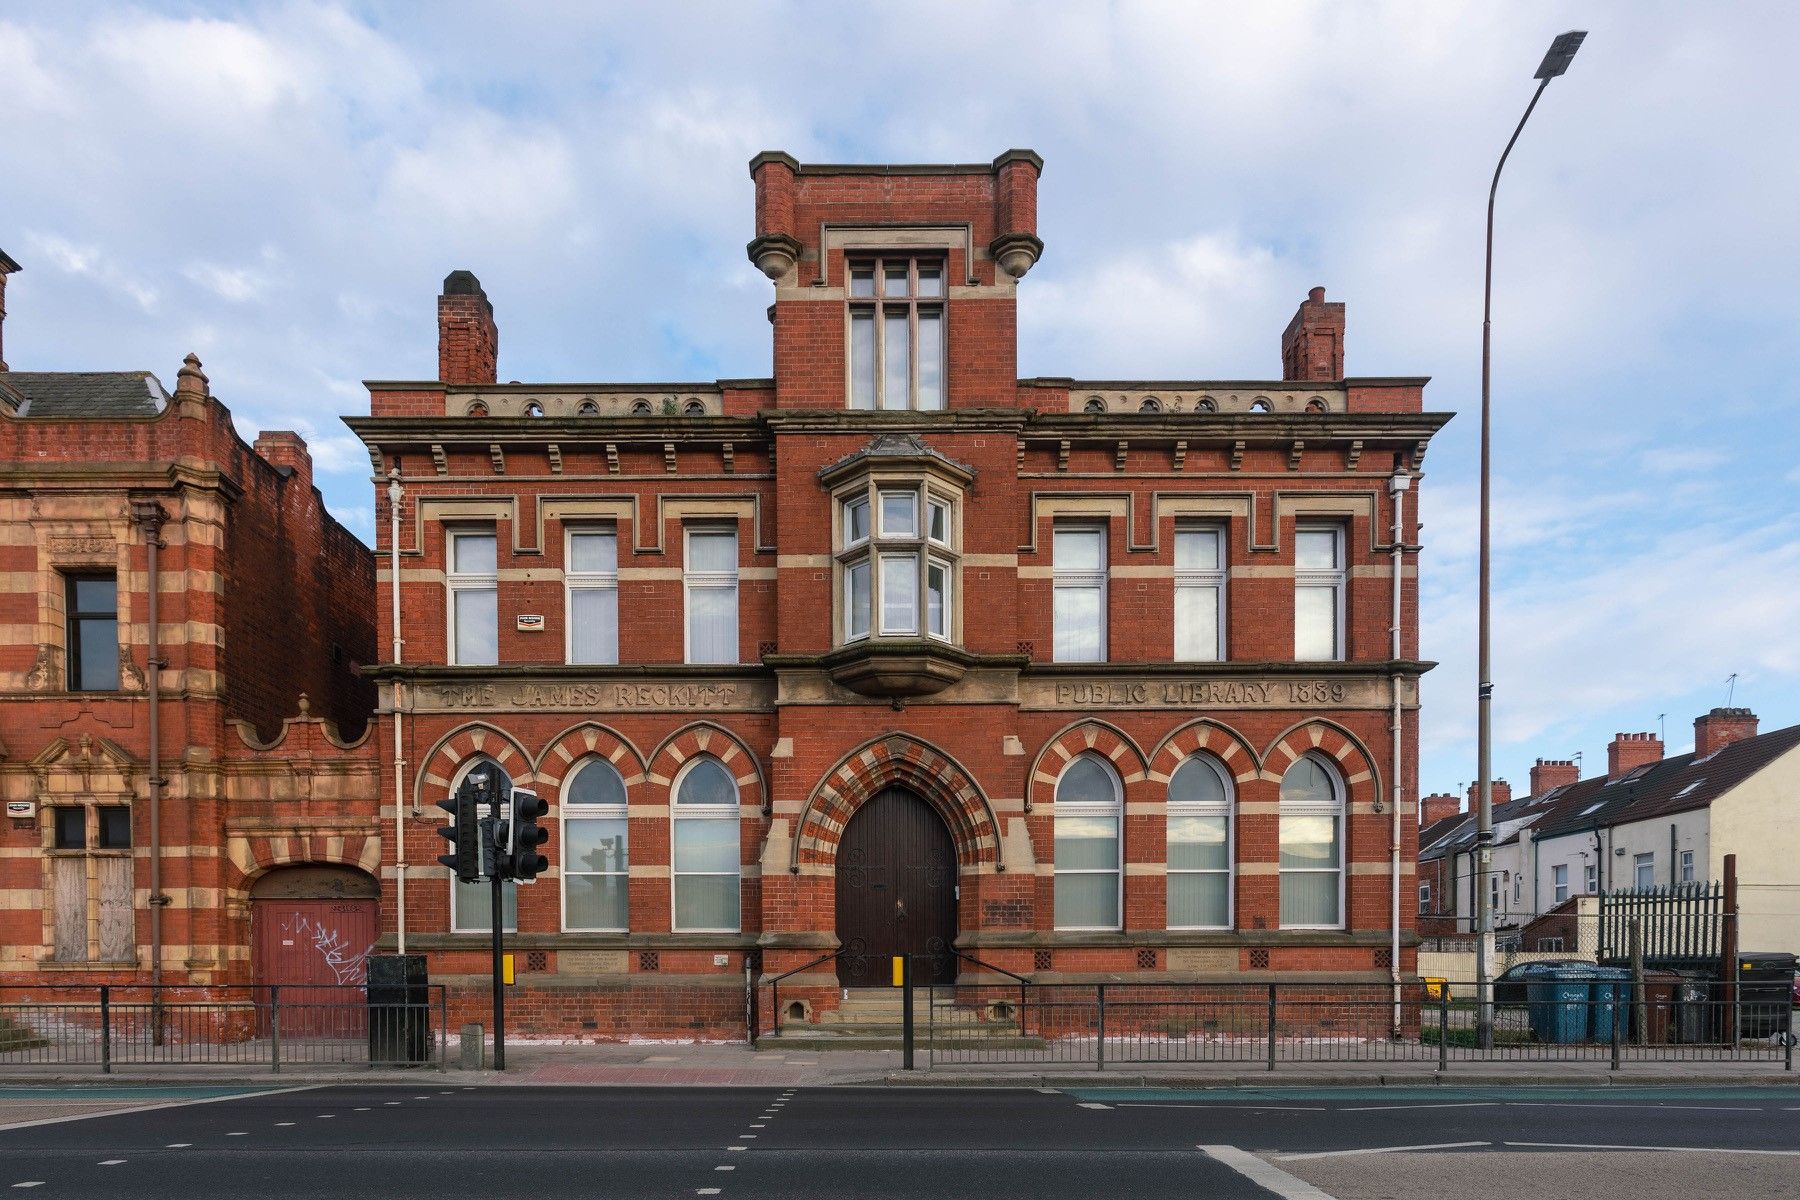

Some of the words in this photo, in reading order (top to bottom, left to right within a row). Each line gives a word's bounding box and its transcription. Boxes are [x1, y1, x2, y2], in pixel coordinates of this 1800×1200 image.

[441, 685, 495, 706] THE
[511, 684, 600, 706] JAMES
[614, 683, 736, 706] RECKITT
[1057, 683, 1146, 704] PUBLIC
[1164, 682, 1277, 703] LIBRARY
[1288, 681, 1346, 703] 1889
